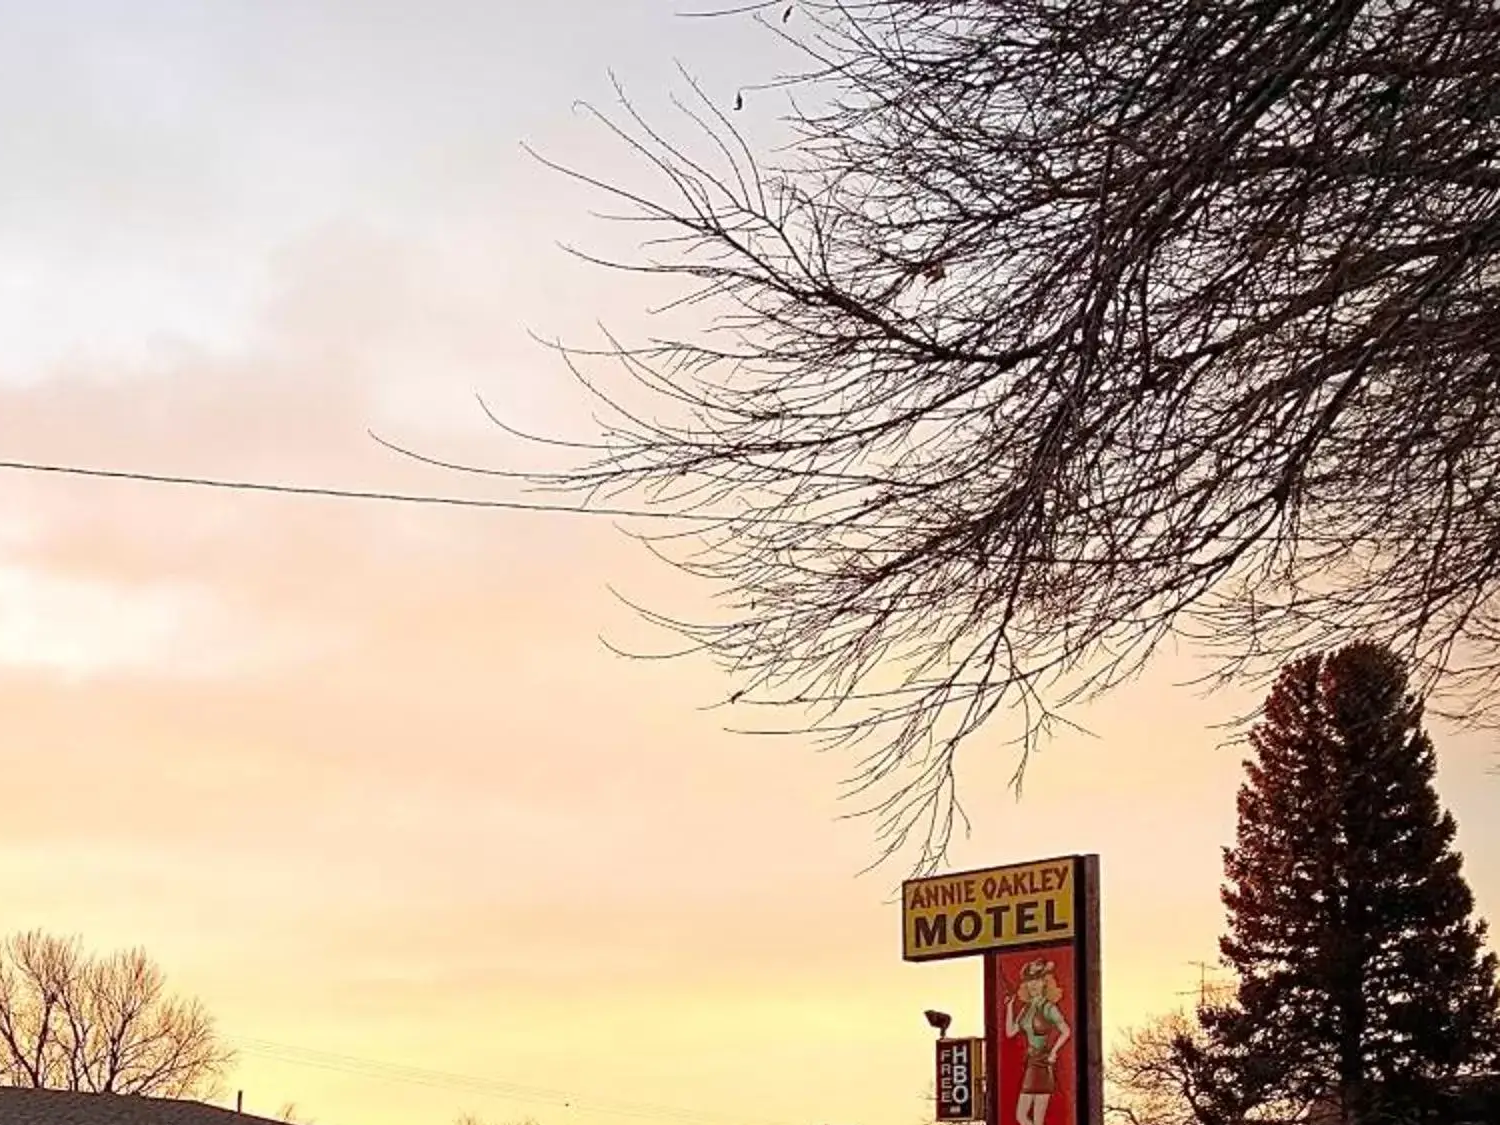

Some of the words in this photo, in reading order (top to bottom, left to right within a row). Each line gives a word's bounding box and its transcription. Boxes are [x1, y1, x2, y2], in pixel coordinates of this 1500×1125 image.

[910, 879, 977, 910] ANNIE
[981, 866, 1069, 900] OAKLEY
[914, 899, 1069, 948] MOTEL
[941, 1049, 952, 1103] FREE
[952, 1045, 969, 1104] HBO
